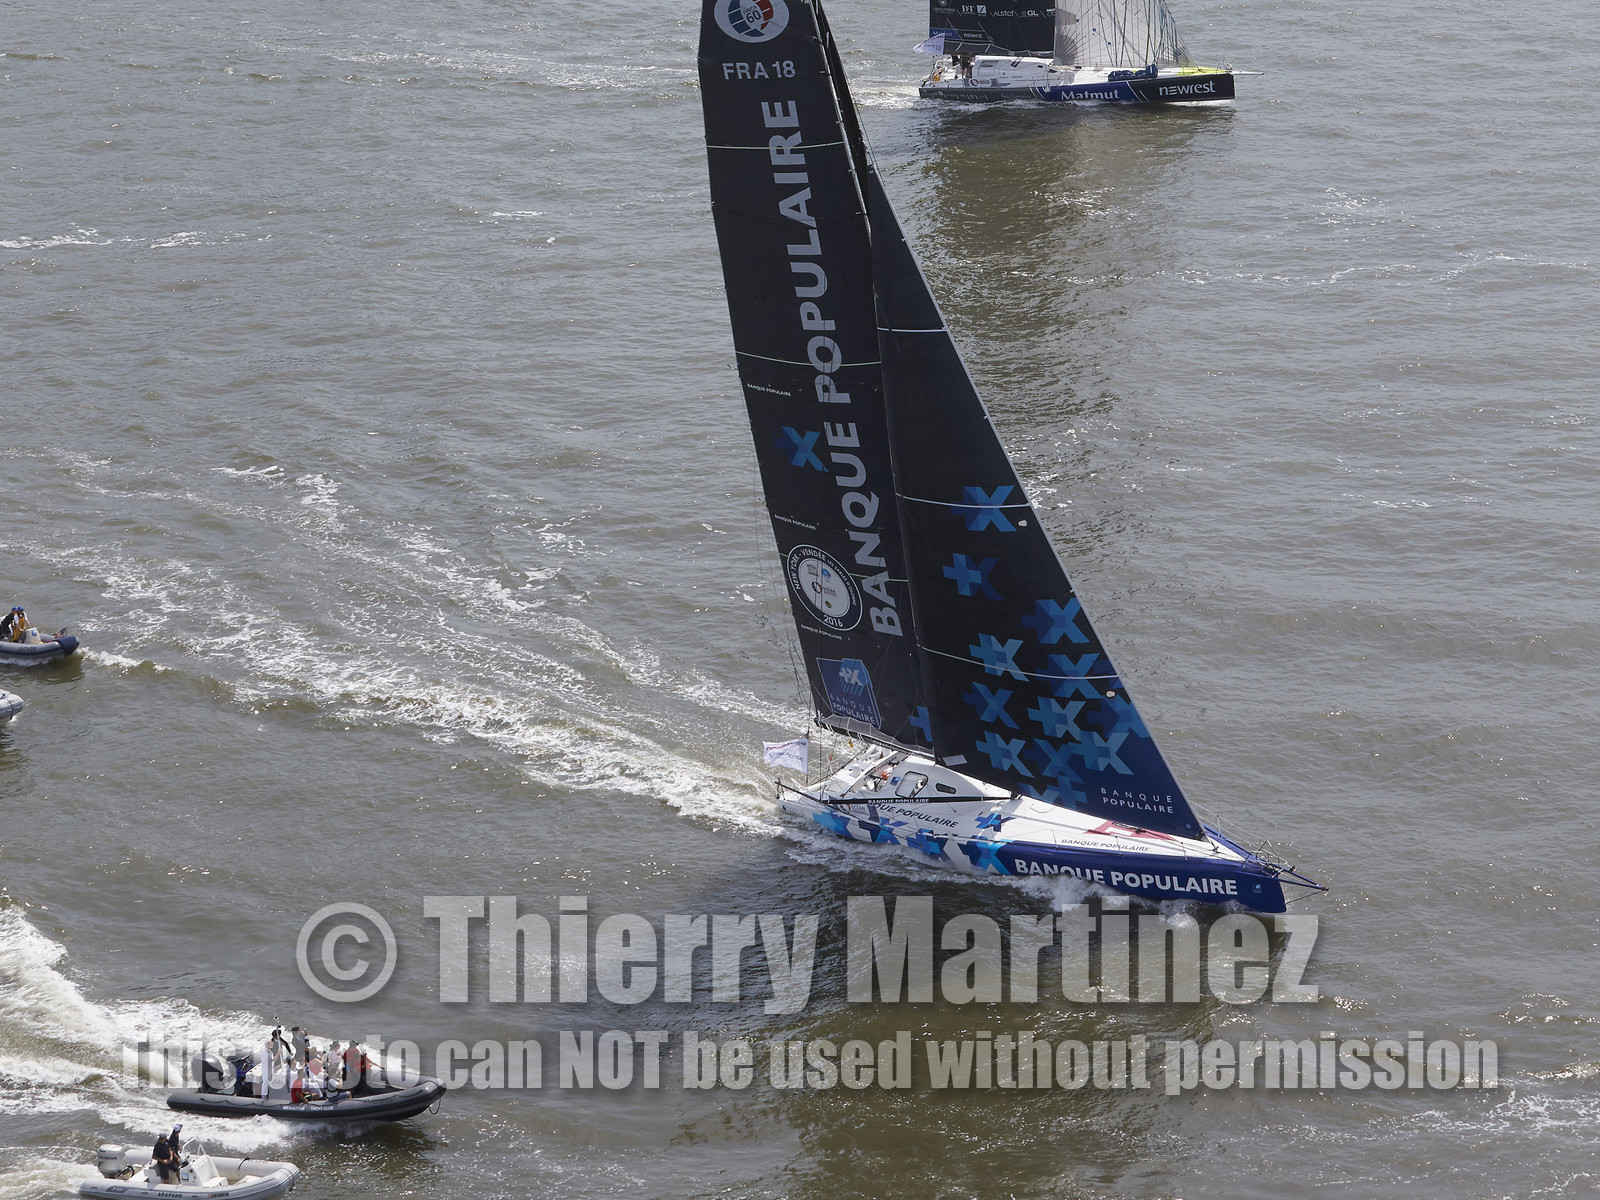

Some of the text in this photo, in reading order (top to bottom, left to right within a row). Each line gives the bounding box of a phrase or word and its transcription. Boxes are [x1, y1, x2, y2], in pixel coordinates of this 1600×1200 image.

[746, 9, 762, 24] 60
[722, 60, 796, 80] FRA 18
[1061, 88, 1120, 100] Matmut
[761, 100, 903, 636] BANQUE POPULAIRE
[790, 553, 801, 571] YORK
[791, 571, 801, 590] NEW
[823, 614, 844, 628] 2016
[829, 693, 874, 714] BANQUE
[832, 701, 877, 725] POPULAIRE
[1100, 787, 1173, 803] BANQUE
[1102, 797, 1174, 814] POPULAIRE
[895, 808, 959, 828] POPULAIRE
[1061, 839, 1151, 852] BANQUE POPULAIRE
[1110, 871, 1238, 896] POPULAIRE
